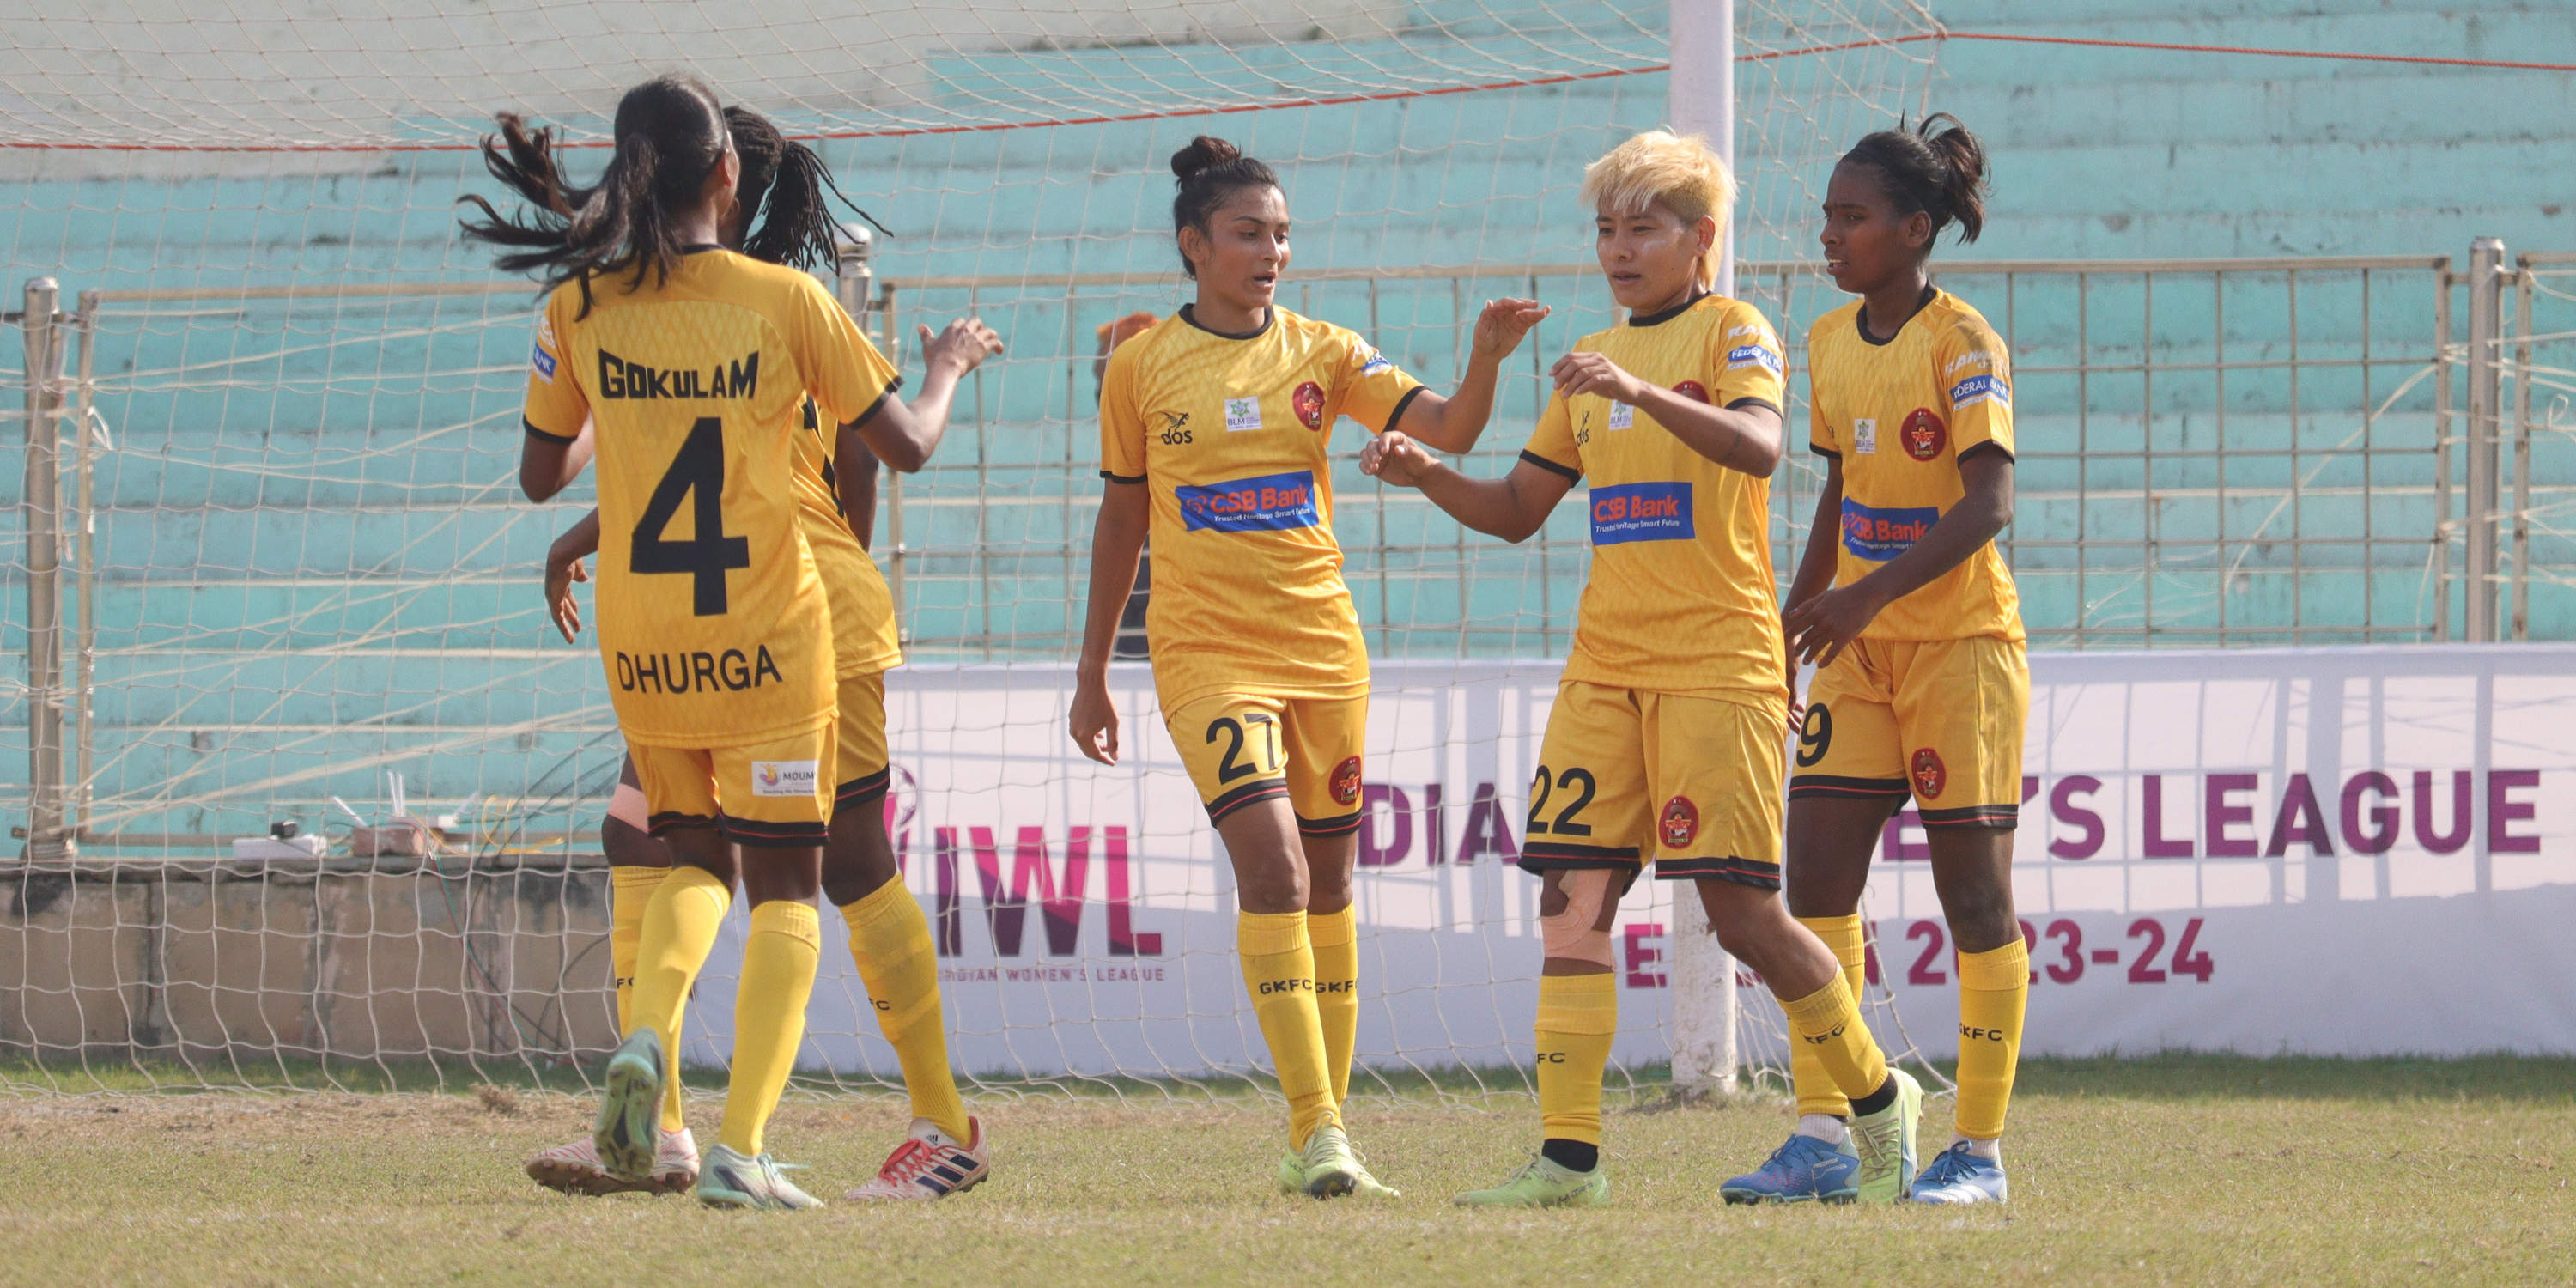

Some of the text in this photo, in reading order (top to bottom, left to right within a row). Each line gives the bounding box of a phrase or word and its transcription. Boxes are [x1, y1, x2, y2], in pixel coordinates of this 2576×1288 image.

[598, 349, 758, 398] GOKULAM
[1228, 417, 1245, 426] BLM
[629, 416, 750, 617] 4
[1209, 483, 1309, 513] CSB Bank
[1275, 509, 1295, 519] Smart
[1594, 495, 1680, 522] CSB Bank
[1876, 519, 1929, 542] Bank
[617, 644, 783, 694] DHURGA
[1206, 713, 1277, 786] 27
[1796, 702, 1832, 768] 9
[1526, 765, 1596, 837] 22
[2142, 769, 2541, 859] LEAGUE
[934, 825, 1163, 957] IWL
[1096, 968, 1164, 982] LEAGUE
[1258, 979, 1313, 995] GKFC
